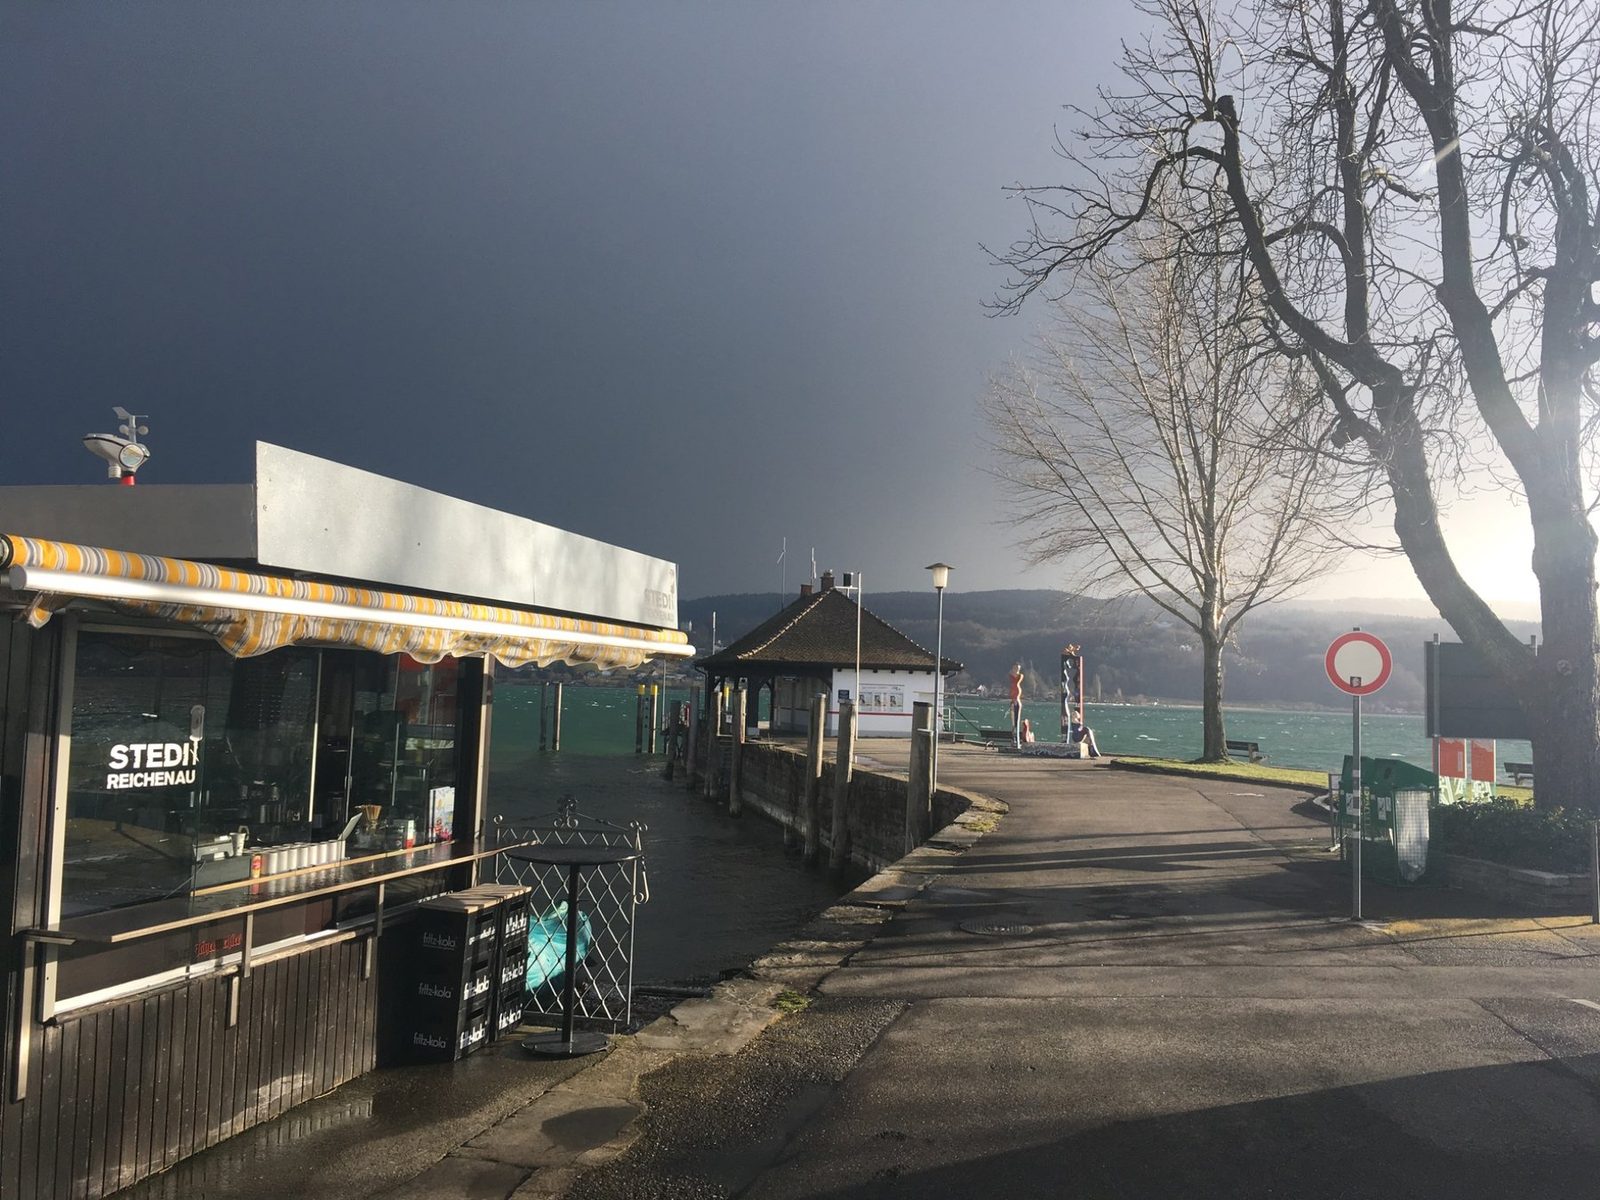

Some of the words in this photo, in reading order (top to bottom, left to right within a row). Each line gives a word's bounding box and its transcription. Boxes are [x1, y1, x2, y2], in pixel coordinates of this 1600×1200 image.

[106, 769, 196, 790] REICHENAU
[418, 982, 452, 999] fritz-kola
[413, 1031, 447, 1049] fritz-kola
